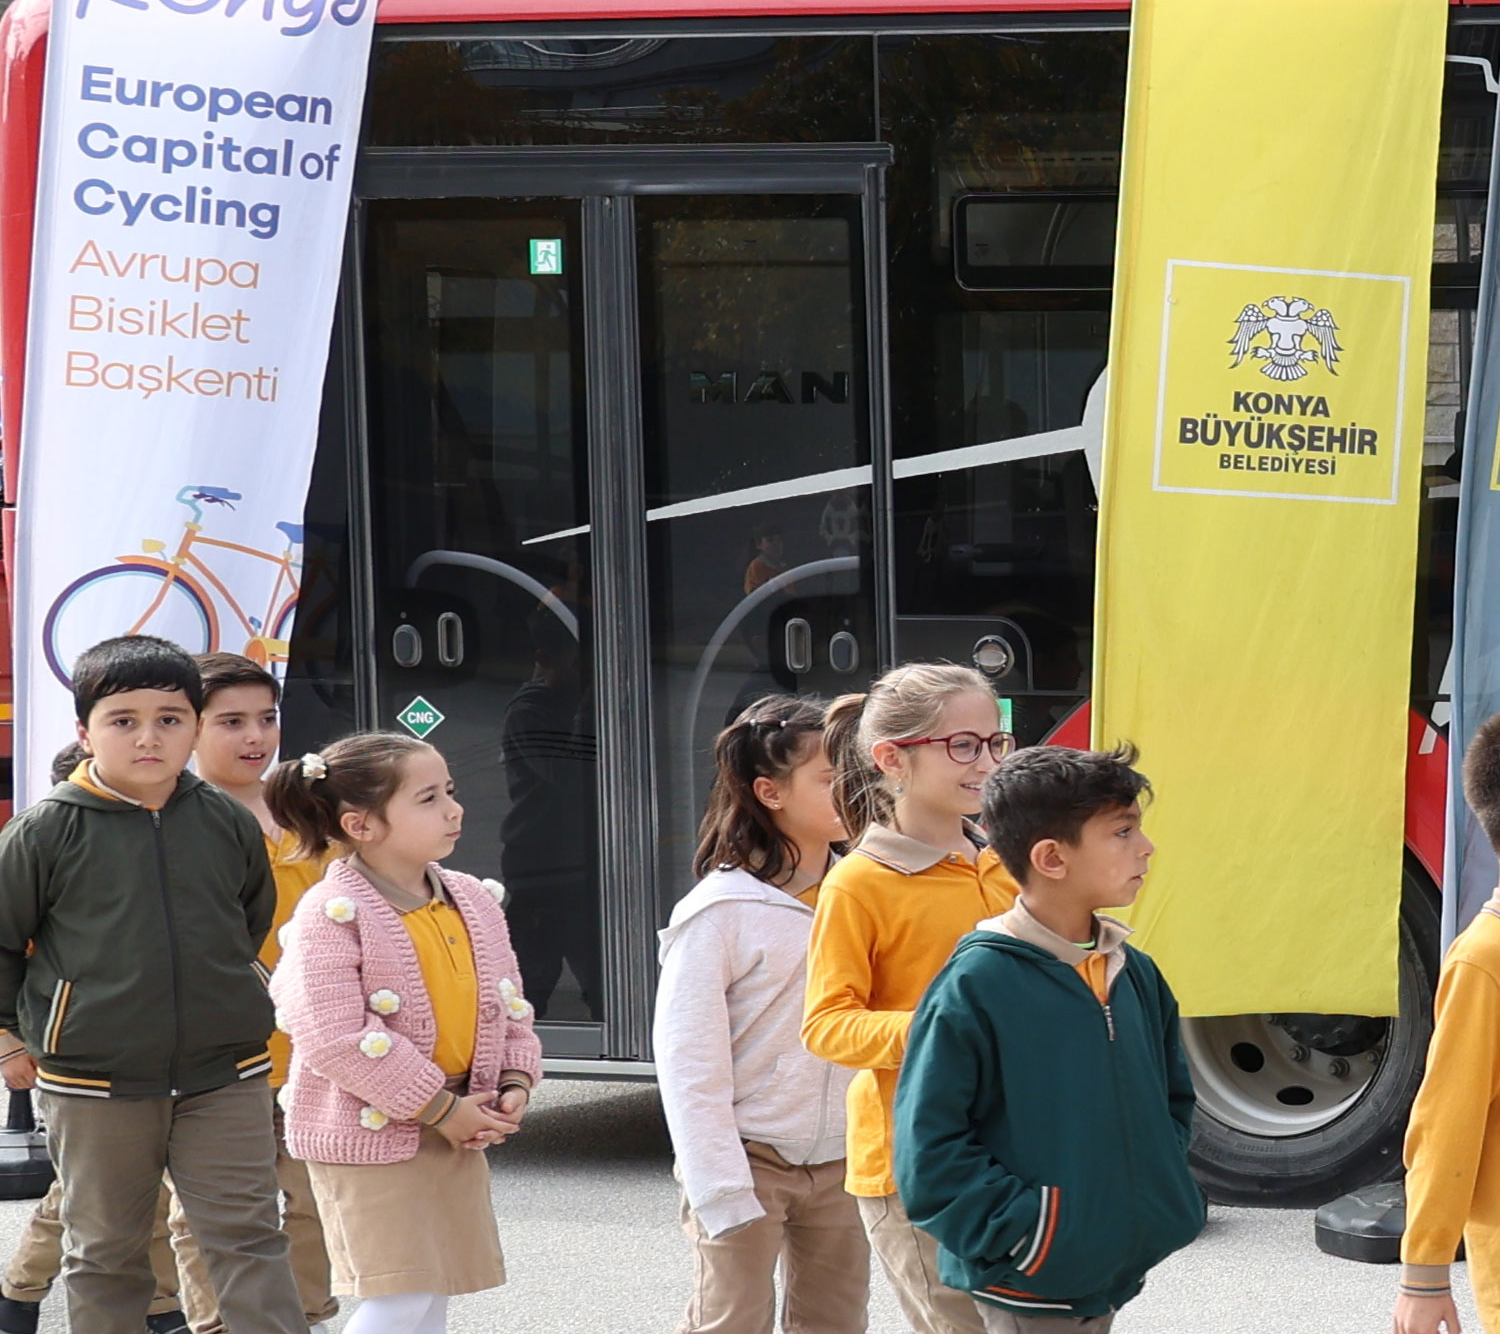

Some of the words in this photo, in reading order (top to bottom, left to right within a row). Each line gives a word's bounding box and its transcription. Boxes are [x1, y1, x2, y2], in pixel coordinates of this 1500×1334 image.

[79, 65, 332, 126] European
[79, 123, 293, 178] Capital
[300, 144, 341, 182] of
[74, 180, 281, 240] Cycling
[69, 239, 260, 293] Avrupa
[68, 294, 250, 346] Bisiklet
[64, 351, 279, 404] Başkenti
[690, 371, 849, 404] MAN
[1233, 391, 1330, 420] KONYA
[1179, 413, 1378, 458] BÜYÜKŞEHİR
[1219, 452, 1337, 476] BELEDİYESİ
[407, 711, 434, 724] CNG
